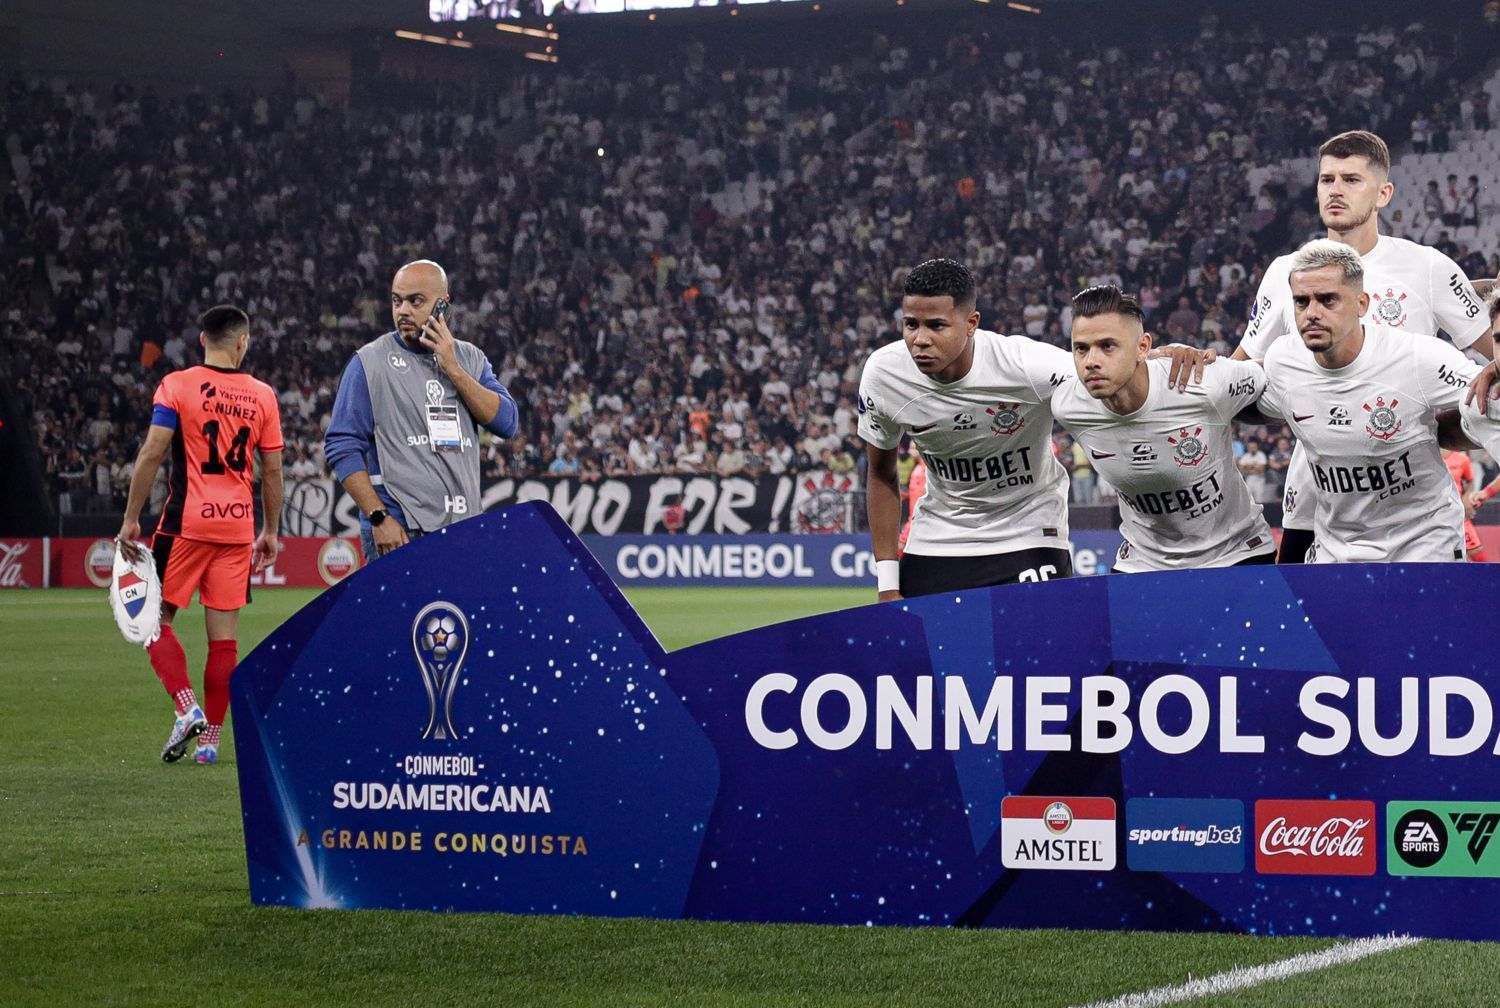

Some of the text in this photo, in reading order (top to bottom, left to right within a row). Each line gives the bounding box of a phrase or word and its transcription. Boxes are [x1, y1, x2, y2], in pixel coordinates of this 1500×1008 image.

[1453, 281, 1481, 319] bmg
[392, 356, 407, 368] 24
[1443, 369, 1468, 389] bm
[202, 400, 257, 422] C. NUÑEZ
[1327, 418, 1352, 426] ALE
[952, 423, 977, 431] ALE
[201, 419, 251, 476] 14
[1131, 454, 1158, 462] ALE
[992, 473, 1034, 491] .COM
[1375, 478, 1416, 504] .COM
[444, 495, 468, 515] HB
[1186, 492, 1224, 521] .COM
[616, 543, 814, 579] CONMEBOL
[125, 588, 138, 599] CN
[743, 673, 1265, 753] CONMEBOL
[404, 755, 478, 777] CONMEBOL
[333, 782, 551, 814] SUDAMERICANA
[1128, 824, 1242, 847] sportingbet
[1258, 816, 1371, 858] Coca-Cola
[1403, 821, 1439, 842] EA
[297, 829, 589, 858] A GRANDE CONQUISTA
[1014, 838, 1104, 862] AMSTEL
[1402, 842, 1440, 853] SPORTS
